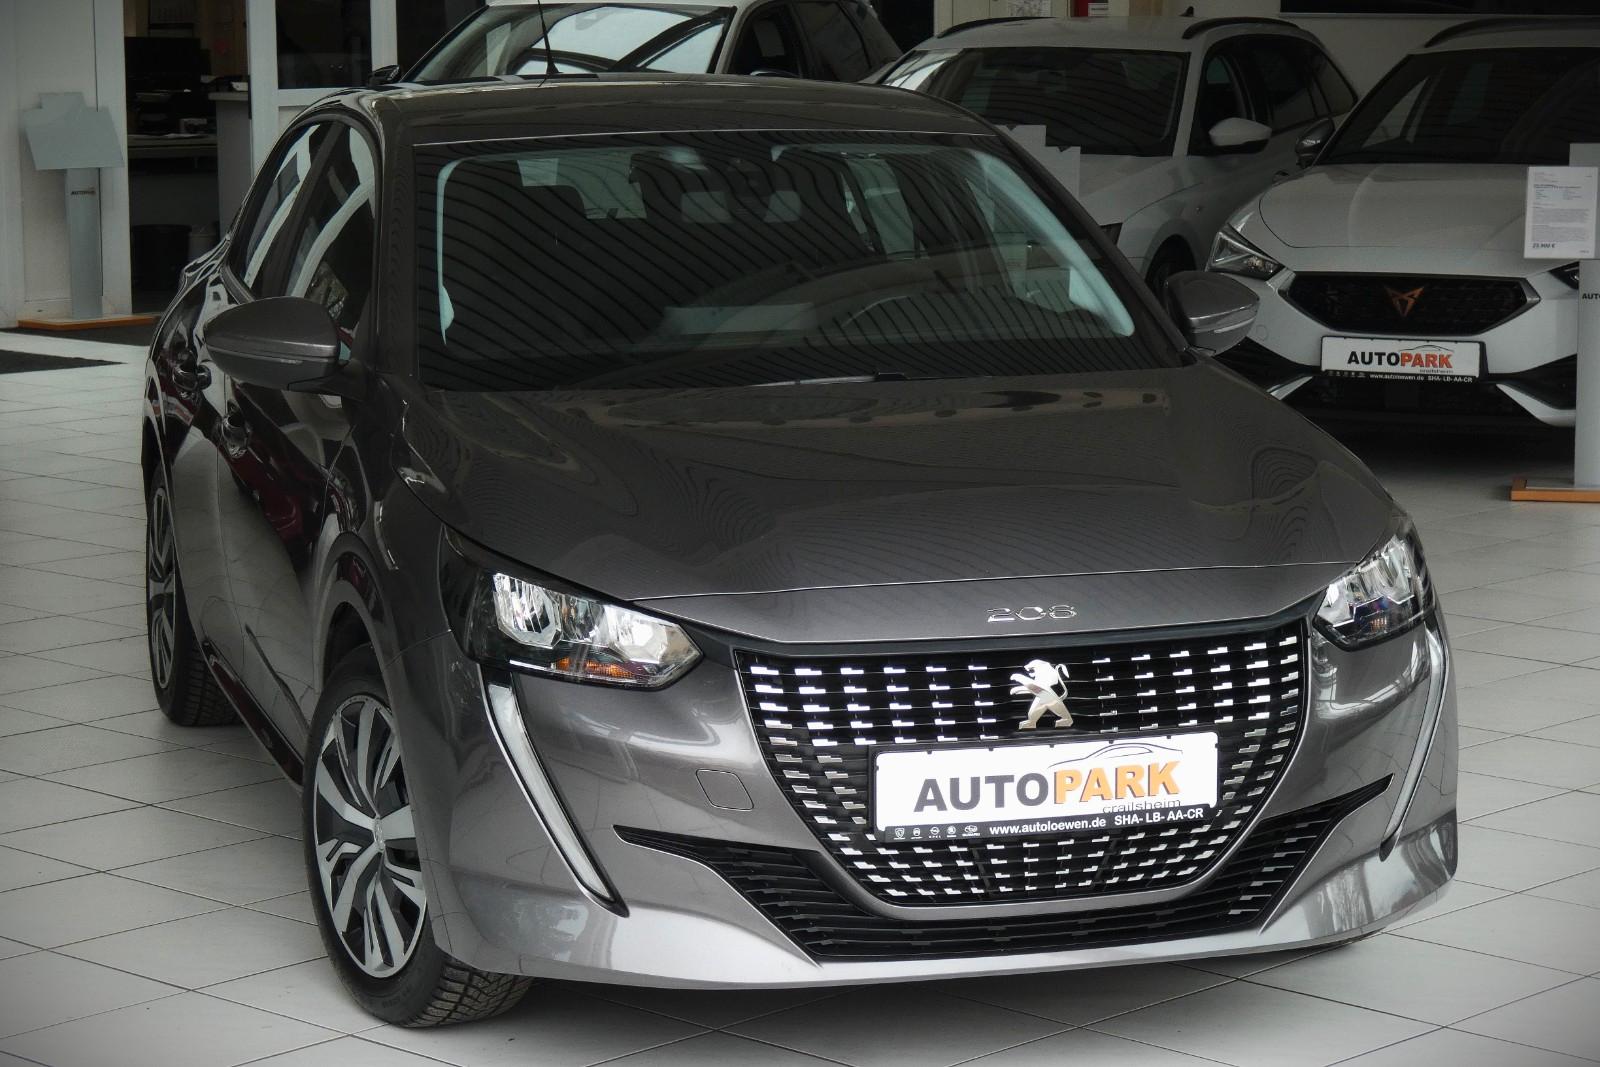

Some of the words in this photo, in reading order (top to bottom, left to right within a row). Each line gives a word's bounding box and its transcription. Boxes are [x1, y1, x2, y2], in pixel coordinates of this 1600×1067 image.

[1347, 351, 1453, 368] AUTOPARK
[914, 760, 1182, 813] AUTOPARK
[1102, 798, 1181, 813] crailsheim
[989, 817, 1107, 835] www.autoloewen.de
[1115, 815, 1143, 826] SHA-
[1167, 808, 1204, 822] AA-CR
